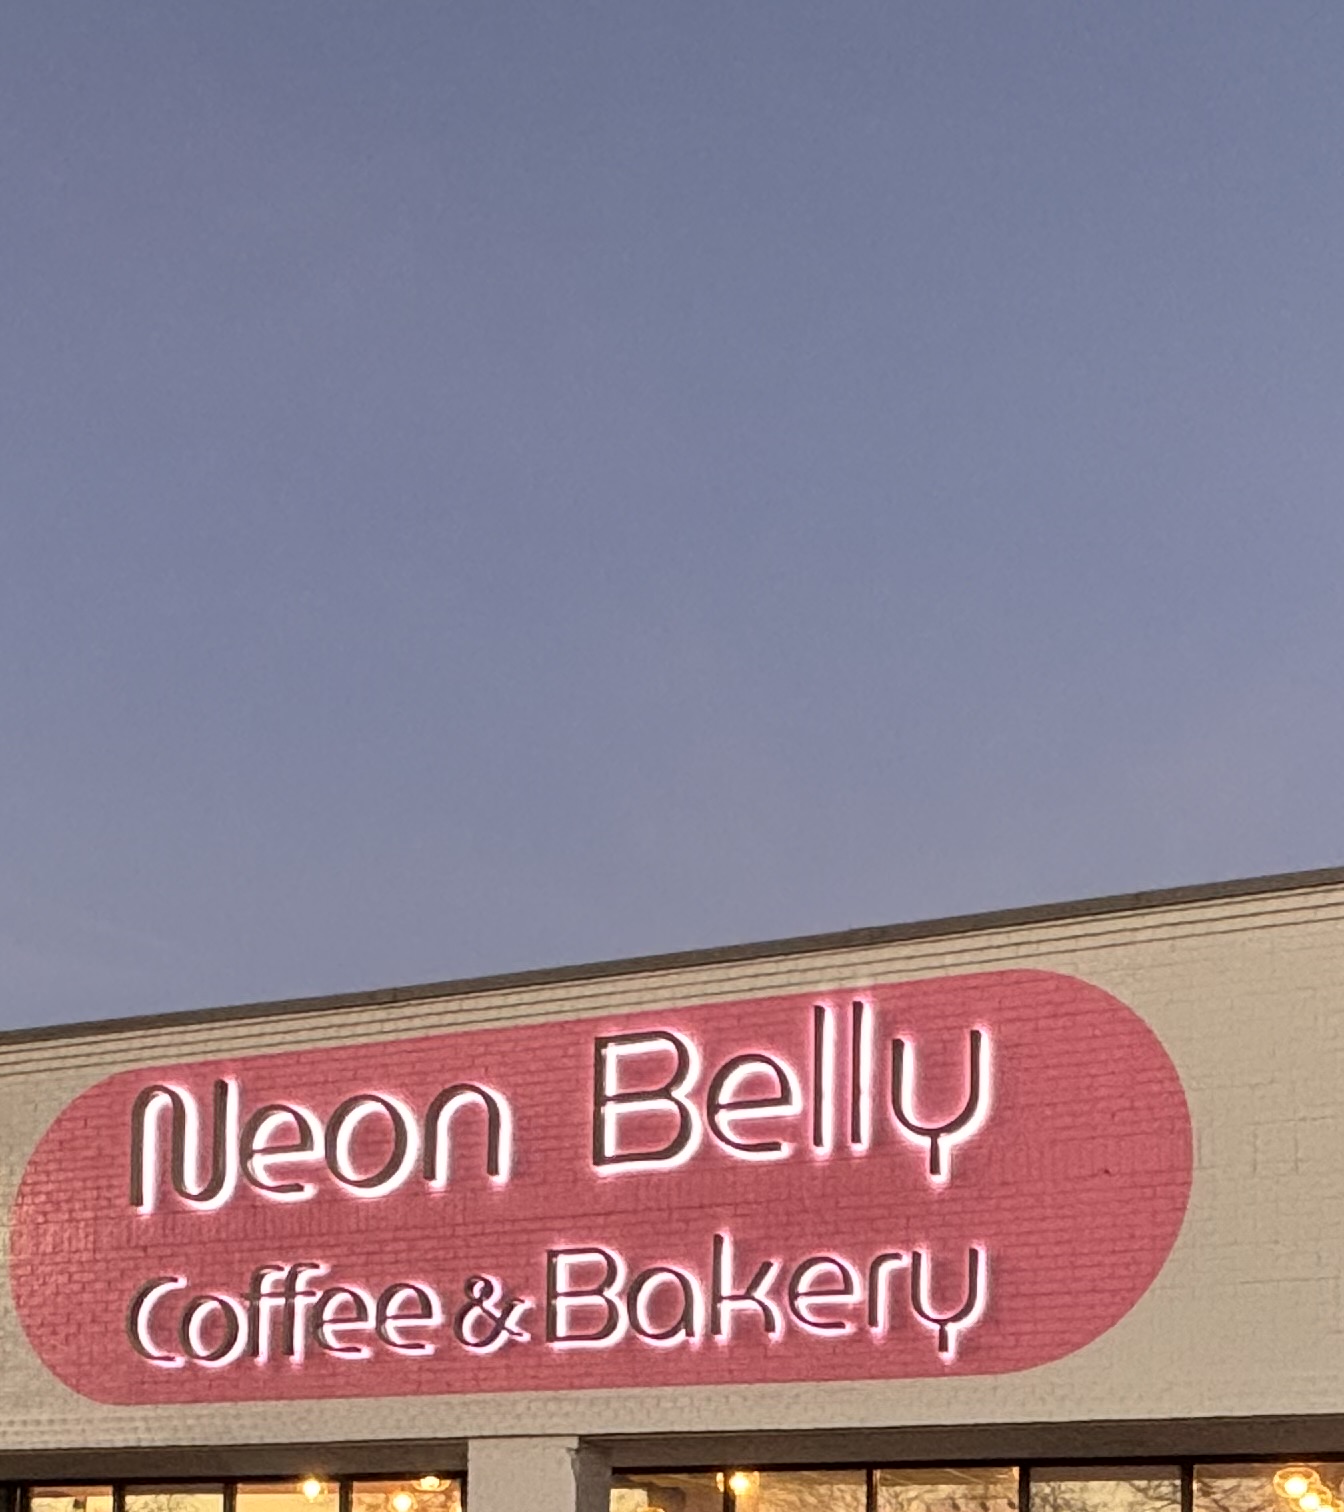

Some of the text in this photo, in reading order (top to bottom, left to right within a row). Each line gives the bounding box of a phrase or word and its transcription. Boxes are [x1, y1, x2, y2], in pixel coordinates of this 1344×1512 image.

[129, 1000, 993, 1215] Neon Belly
[127, 1231, 990, 1368] Coffee & Bakery
